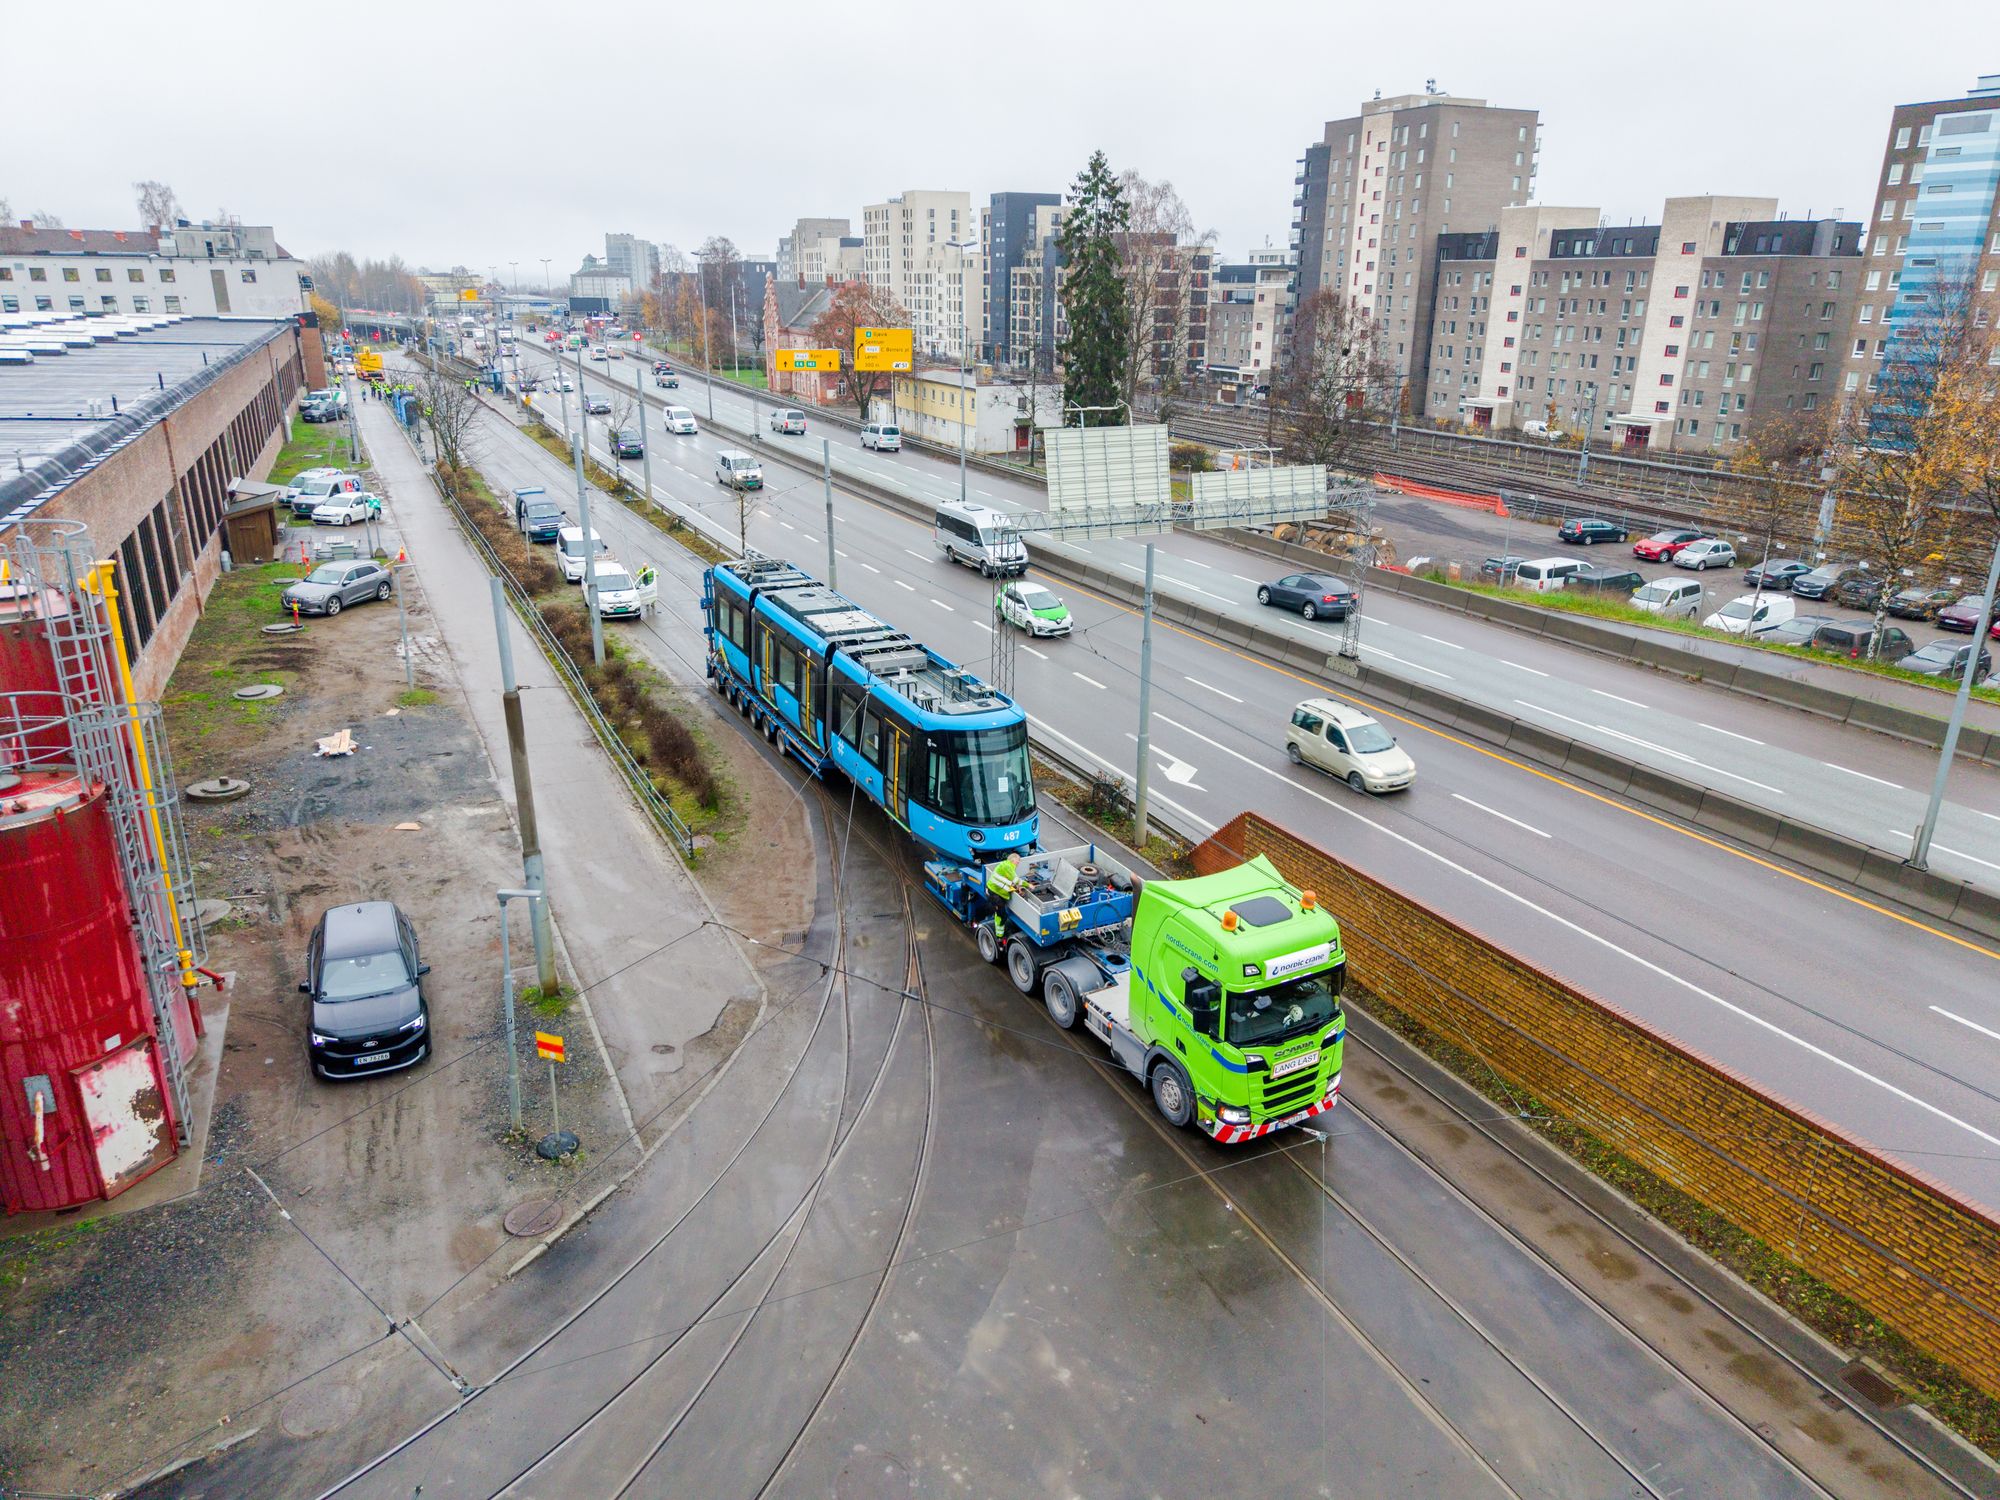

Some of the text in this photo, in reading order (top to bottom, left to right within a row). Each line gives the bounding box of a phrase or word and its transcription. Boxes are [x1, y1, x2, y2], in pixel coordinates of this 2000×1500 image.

[1003, 830, 1020, 841] 487
[1165, 933, 1219, 973] nordiccrane.com
[1304, 953, 1325, 965] crane
[1274, 1040, 1315, 1058] SCANIA
[1274, 1053, 1318, 1074] LANG LAST
